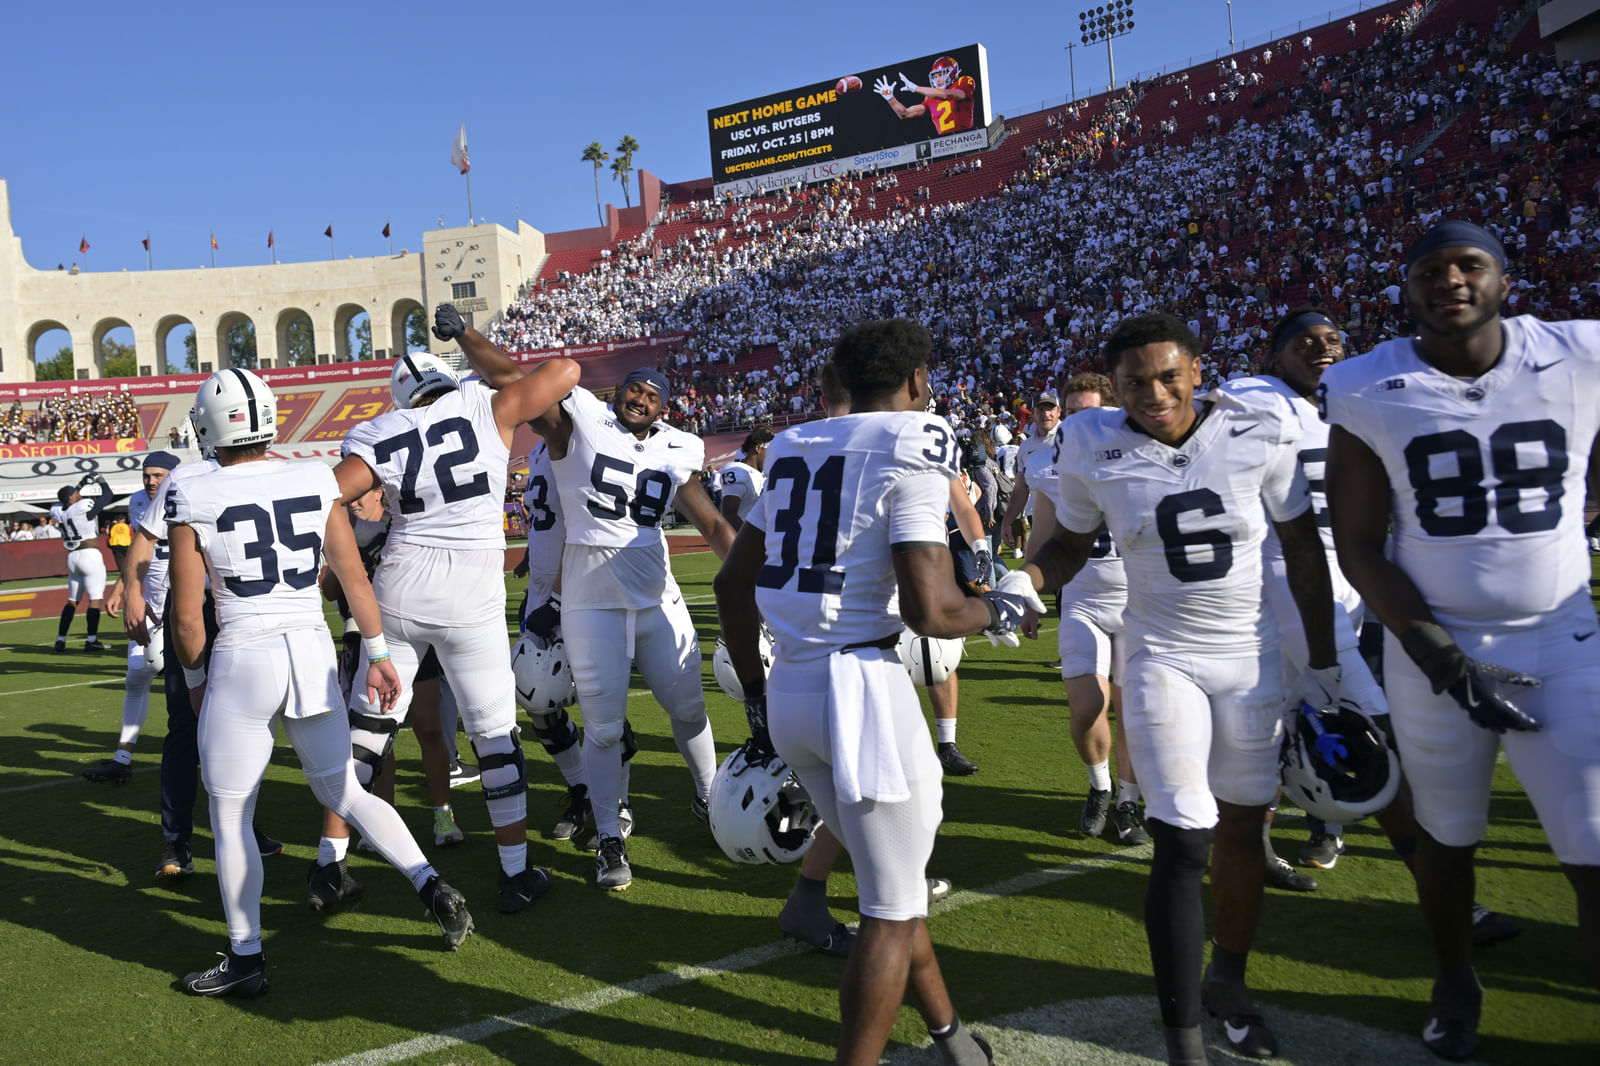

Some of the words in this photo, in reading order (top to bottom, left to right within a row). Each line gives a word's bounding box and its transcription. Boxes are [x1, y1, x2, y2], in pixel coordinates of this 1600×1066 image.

[714, 110, 750, 130] NEXT
[752, 100, 793, 121] HOME
[796, 89, 837, 110] GAME
[730, 128, 751, 141] USC
[752, 125, 770, 136] VS.
[772, 112, 821, 132] RUTGERS
[936, 100, 955, 132] 2
[721, 142, 760, 159] FRIDAY,
[762, 137, 787, 150] OCT.
[789, 133, 802, 144] 25
[810, 126, 834, 140] 8PM
[854, 150, 899, 165] SmartStop
[934, 133, 982, 148] PECHANGA
[725, 144, 832, 174] USCTROJANS.COM/TICKETS
[716, 184, 742, 198] Kck
[812, 163, 840, 179] USC
[332, 402, 384, 422] 13
[20, 443, 100, 458] SECTION
[373, 416, 491, 514] 72
[922, 423, 958, 474] 31
[587, 453, 672, 527] 58
[722, 471, 736, 485] 13
[1404, 418, 1568, 536] 88
[755, 455, 846, 595] 31
[1155, 487, 1233, 583] 6
[217, 494, 322, 597] 35
